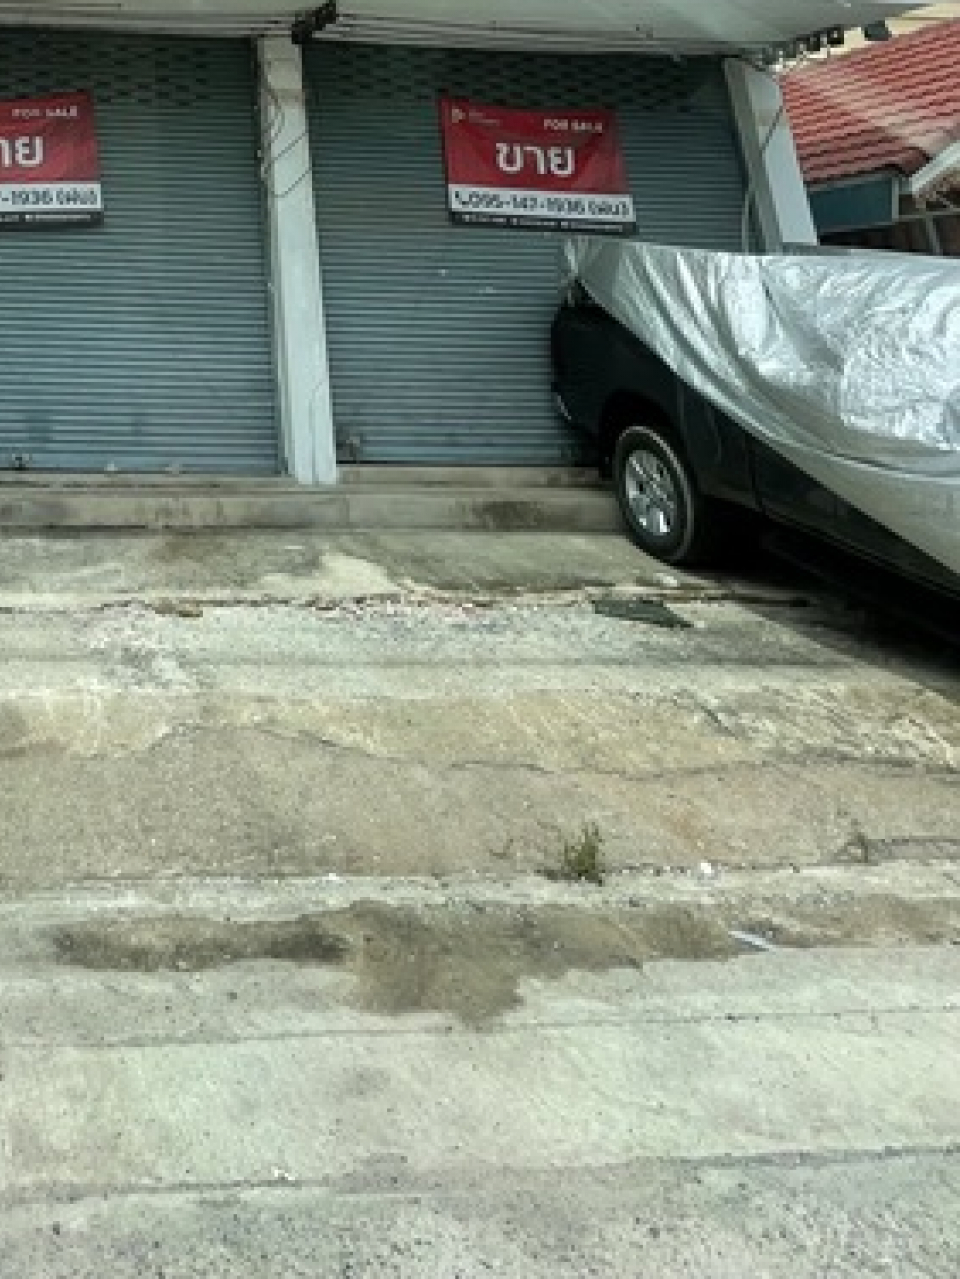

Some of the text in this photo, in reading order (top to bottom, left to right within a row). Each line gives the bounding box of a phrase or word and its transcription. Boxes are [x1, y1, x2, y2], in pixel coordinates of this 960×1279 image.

[12, 105, 78, 118] FOR SALE
[543, 118, 603, 132] FOR SALE
[496, 142, 575, 177] ขาย
